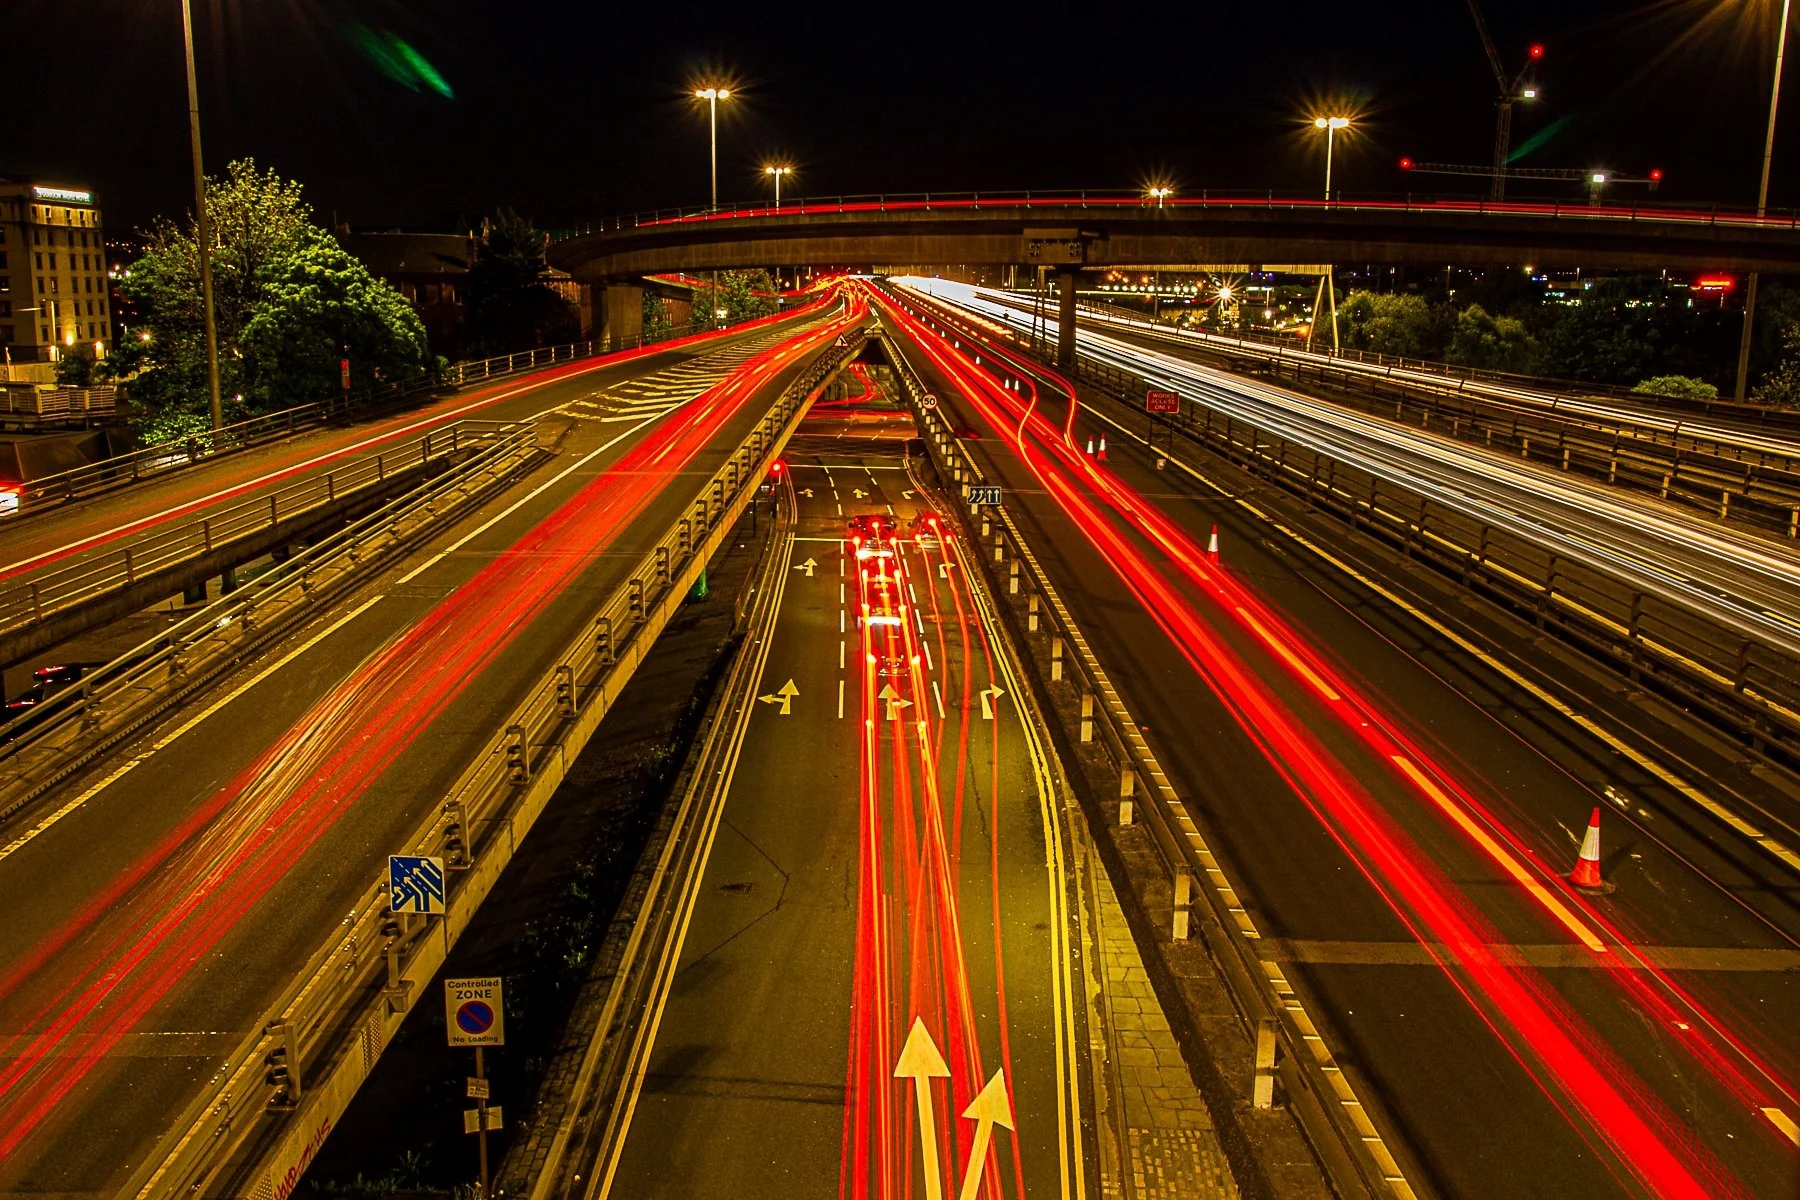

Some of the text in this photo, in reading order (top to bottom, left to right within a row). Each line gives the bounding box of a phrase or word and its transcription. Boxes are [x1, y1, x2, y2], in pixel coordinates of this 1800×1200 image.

[923, 397, 936, 406] 50
[447, 979, 499, 989] Controlled
[456, 989, 492, 1000] ZONE
[468, 1035, 498, 1043] Loading
